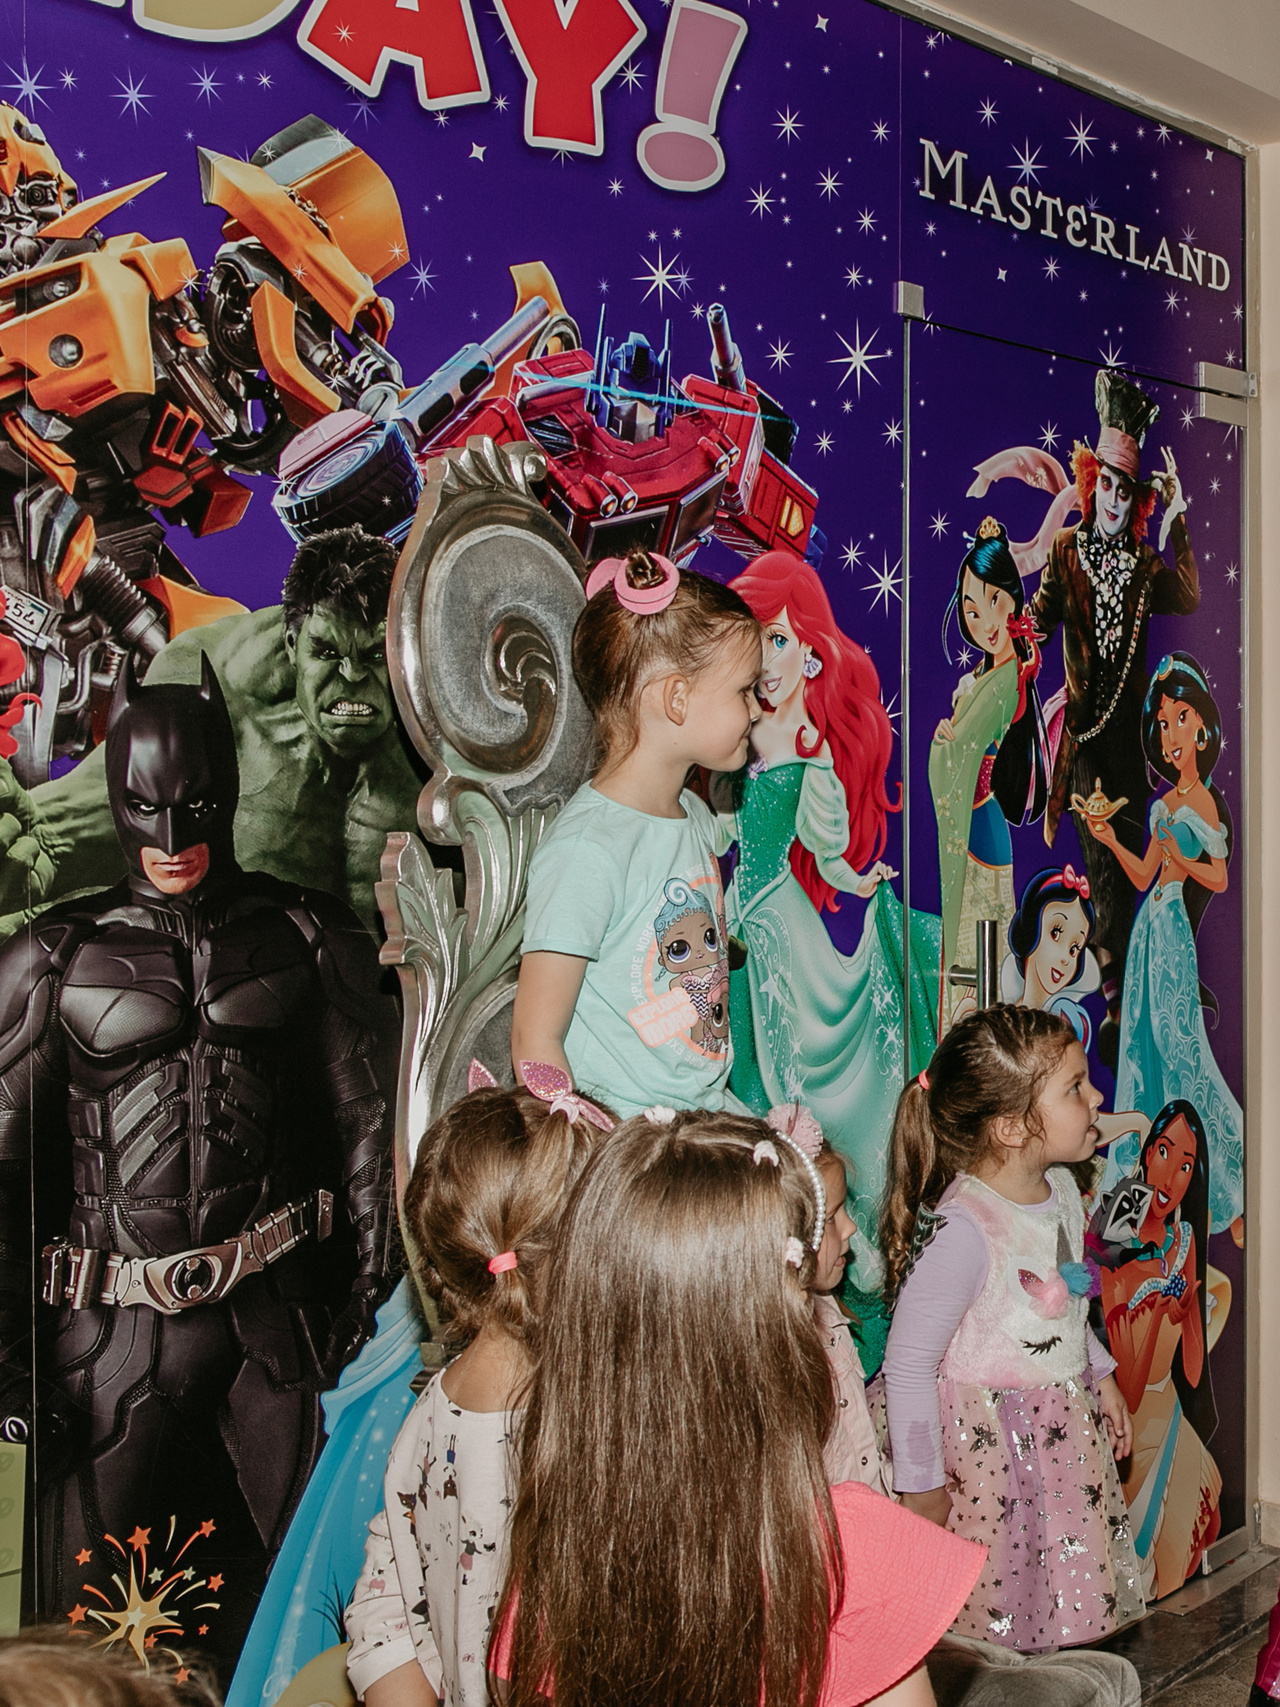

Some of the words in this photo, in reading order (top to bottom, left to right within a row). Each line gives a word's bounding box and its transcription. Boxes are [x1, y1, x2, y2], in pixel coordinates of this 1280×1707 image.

[88, 0, 748, 192] AY!
[6, 597, 35, 626] 54
[636, 922, 654, 953] MORE
[630, 955, 649, 1006] EXPLORE
[641, 1004, 697, 1046] MORE
